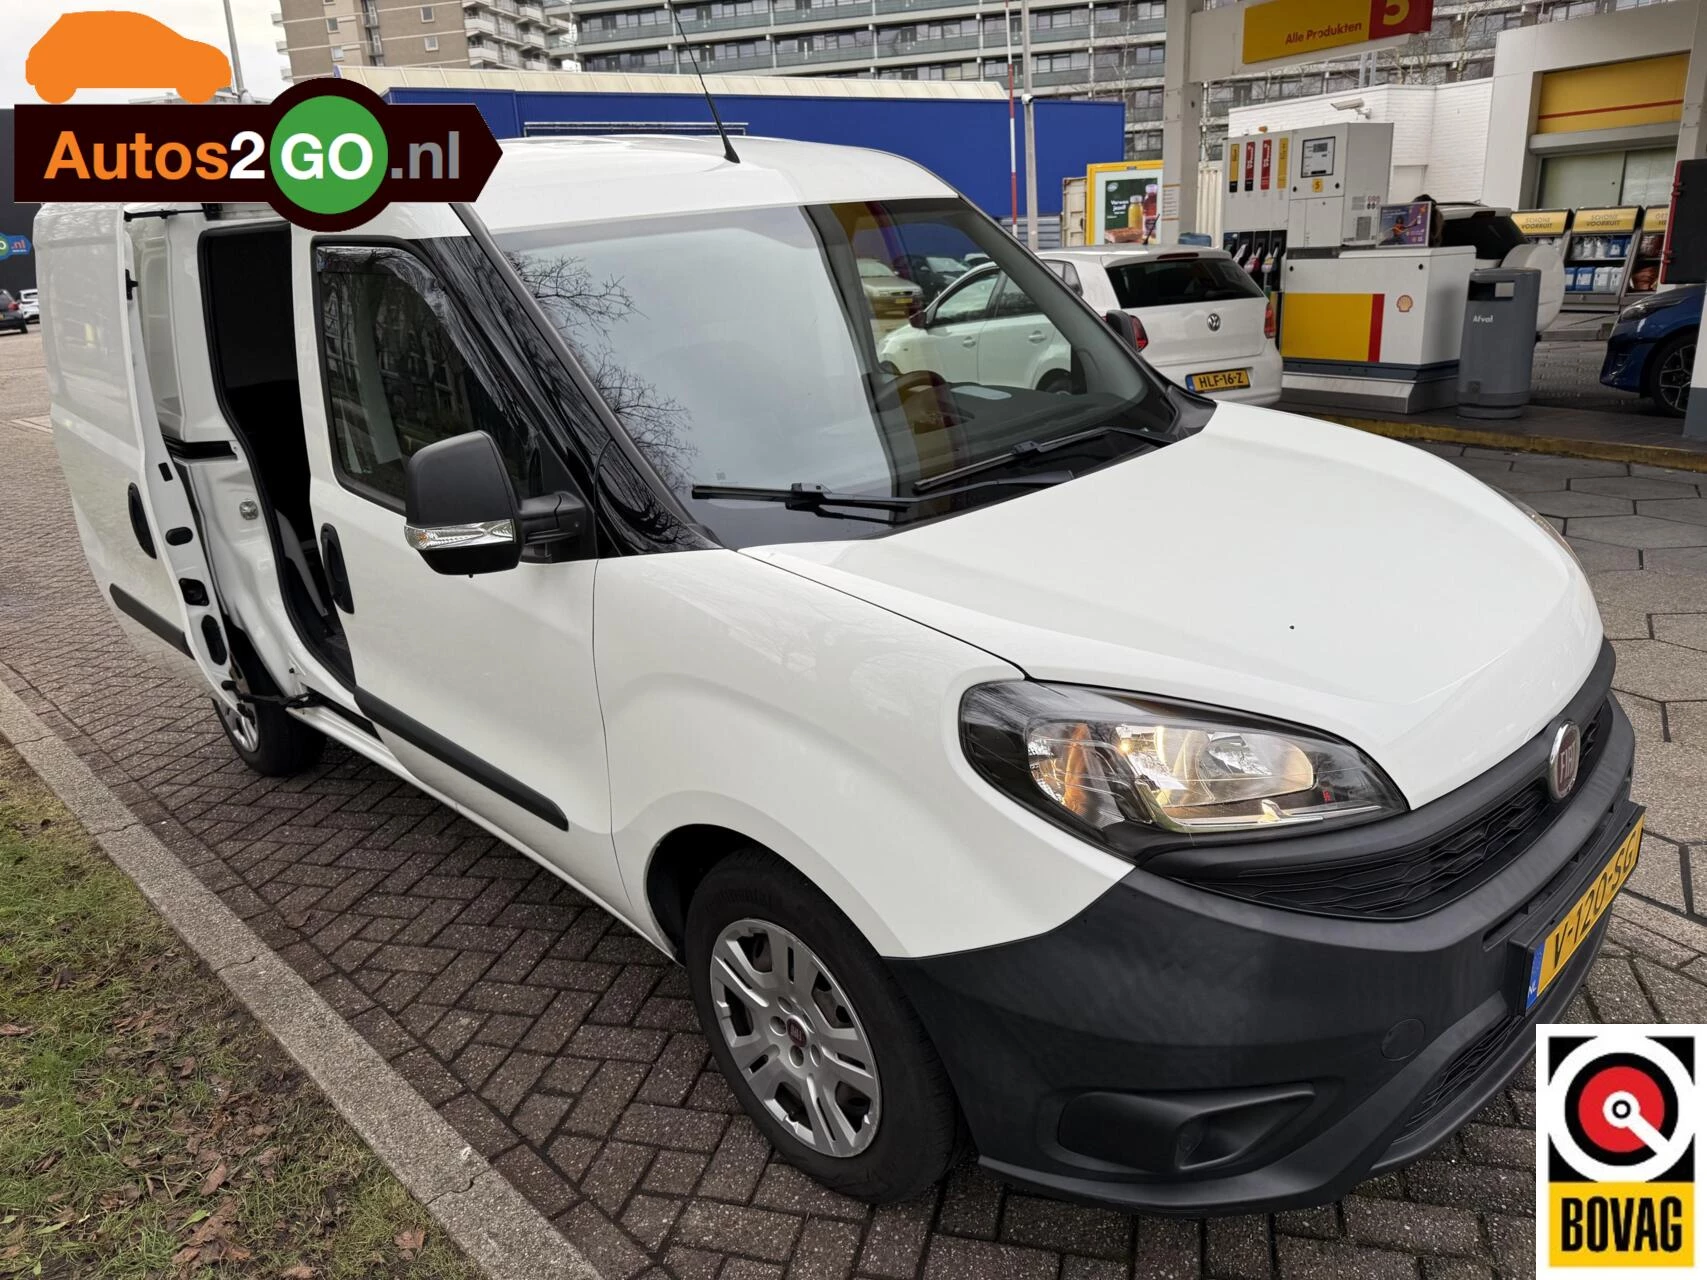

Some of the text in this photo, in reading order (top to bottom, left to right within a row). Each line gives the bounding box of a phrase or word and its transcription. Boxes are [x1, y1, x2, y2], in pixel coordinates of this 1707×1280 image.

[1285, 22, 1362, 45] Alle Produkten
[1473, 314, 1494, 323] Afval
[1198, 372, 1244, 389] HLF-16-Z
[1553, 830, 1638, 970] V-120-SG
